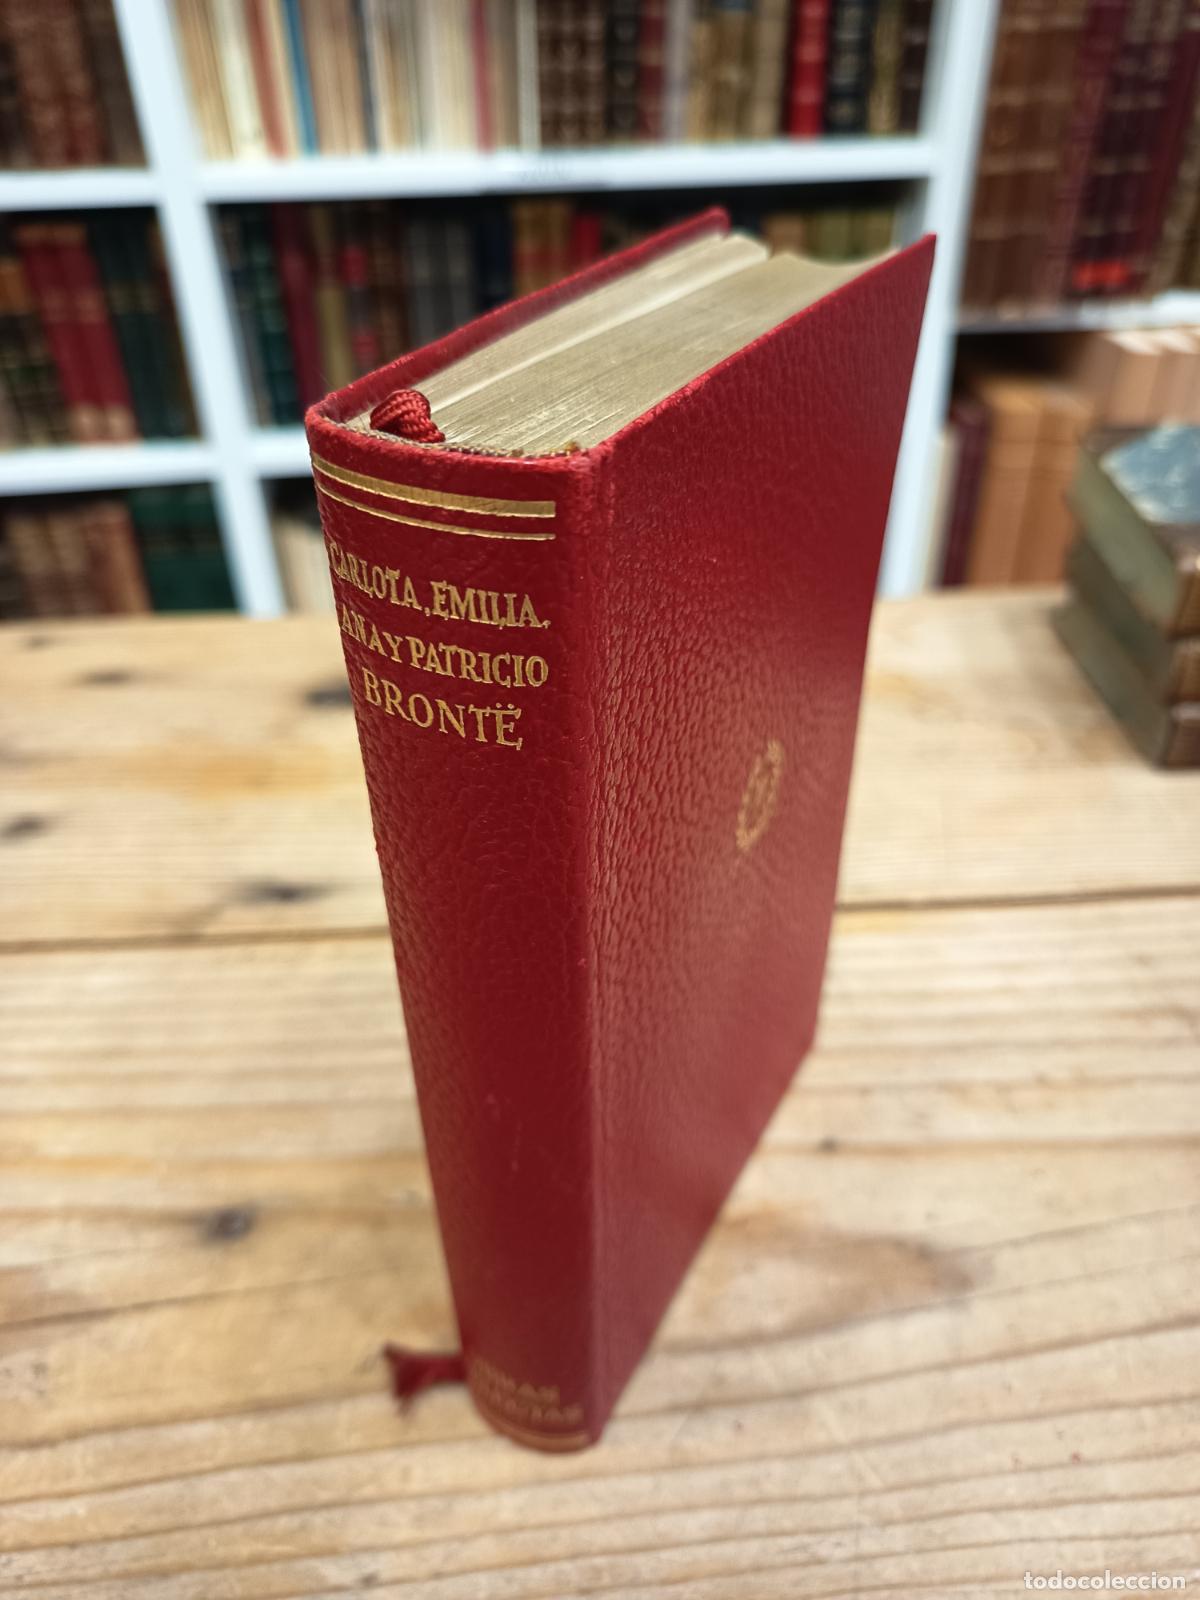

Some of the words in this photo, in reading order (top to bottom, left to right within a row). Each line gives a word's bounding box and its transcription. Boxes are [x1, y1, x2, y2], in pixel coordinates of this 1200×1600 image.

[341, 604, 386, 656] ANA
[382, 631, 403, 663] Y
[405, 635, 549, 688] PATRICIO
[361, 667, 522, 751] BRONTË
